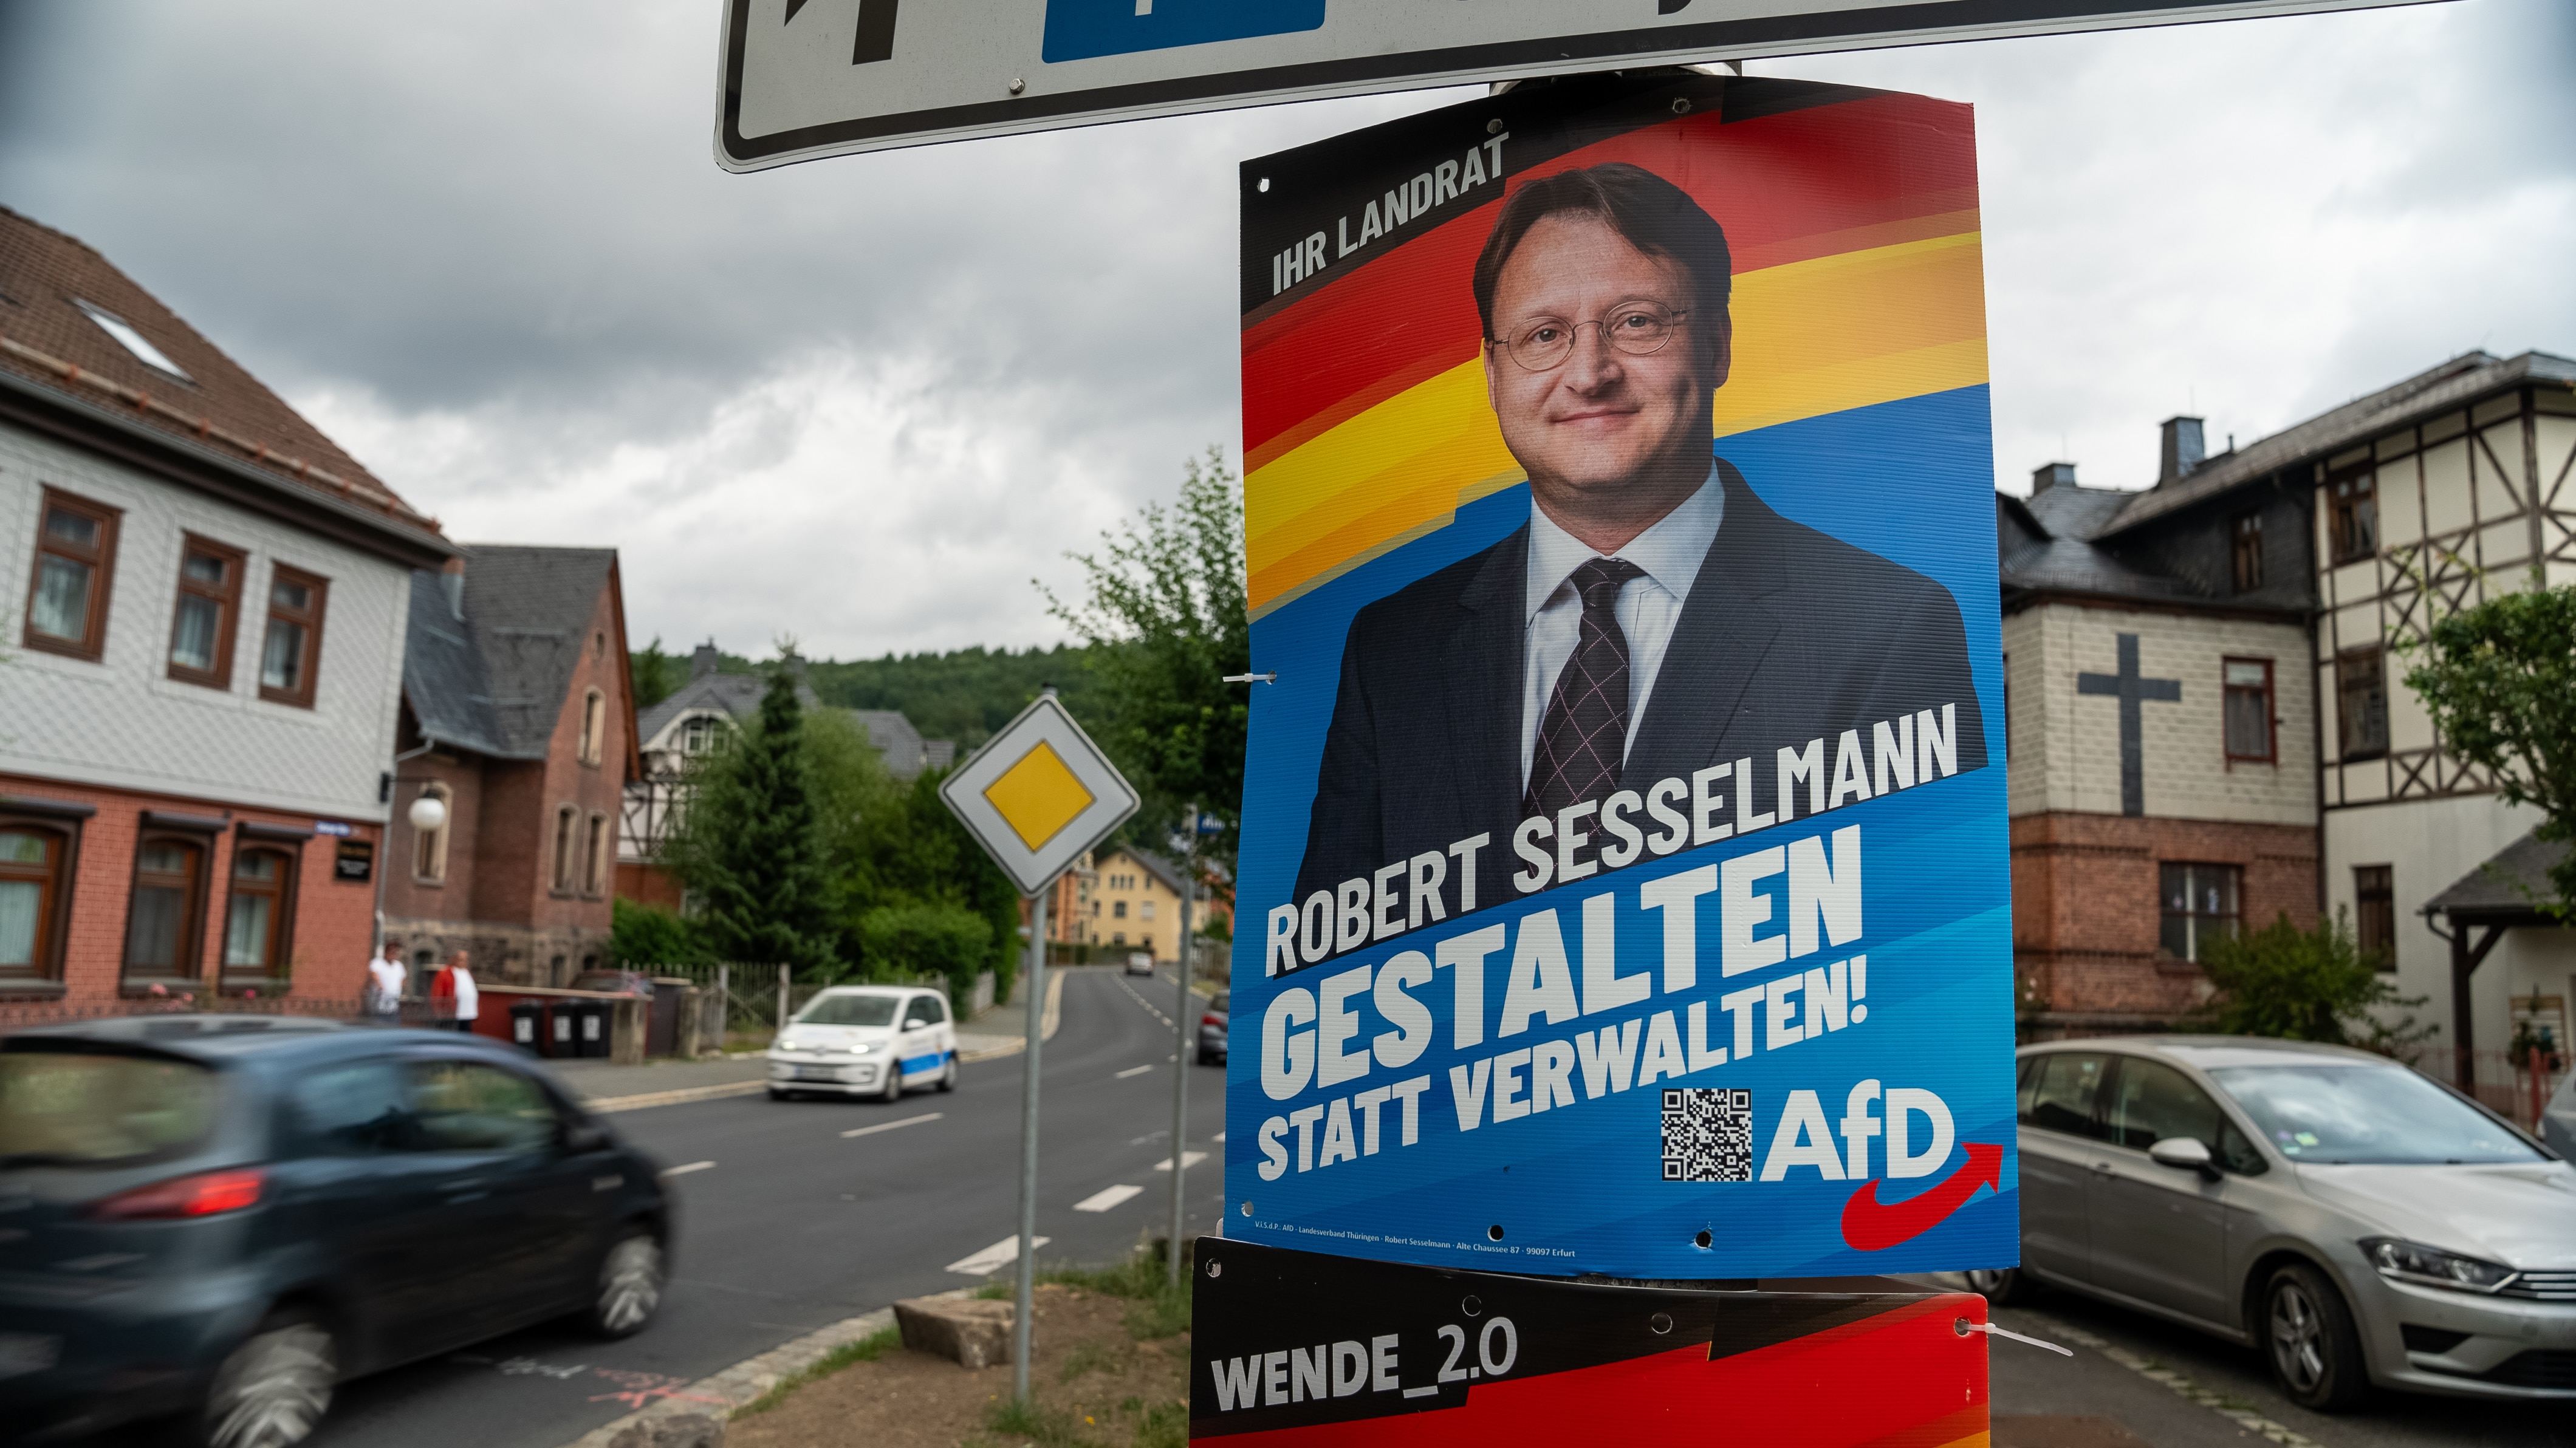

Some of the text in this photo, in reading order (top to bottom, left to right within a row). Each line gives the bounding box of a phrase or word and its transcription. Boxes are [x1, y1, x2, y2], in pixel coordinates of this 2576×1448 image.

[1273, 131, 1509, 296] IHR LANDRAT
[1265, 702, 1958, 978] ROBERT SESSELMANN
[1261, 824, 1863, 1101] GESTALTEN
[1258, 954, 1868, 1181] STATT VERWALTEN!
[1759, 1078, 1955, 1181] AfD
[1299, 1226, 1345, 1238] Landesverband
[1347, 1231, 1379, 1242] Thüringen
[1385, 1235, 1408, 1245] Robert
[1410, 1238, 1451, 1248] Sesselmann
[1456, 1242, 1471, 1251] Alte
[1473, 1243, 1509, 1253] Chaussee
[1526, 1247, 1550, 1255] 99097
[1211, 1316, 1518, 1412] WENDE_2.0
